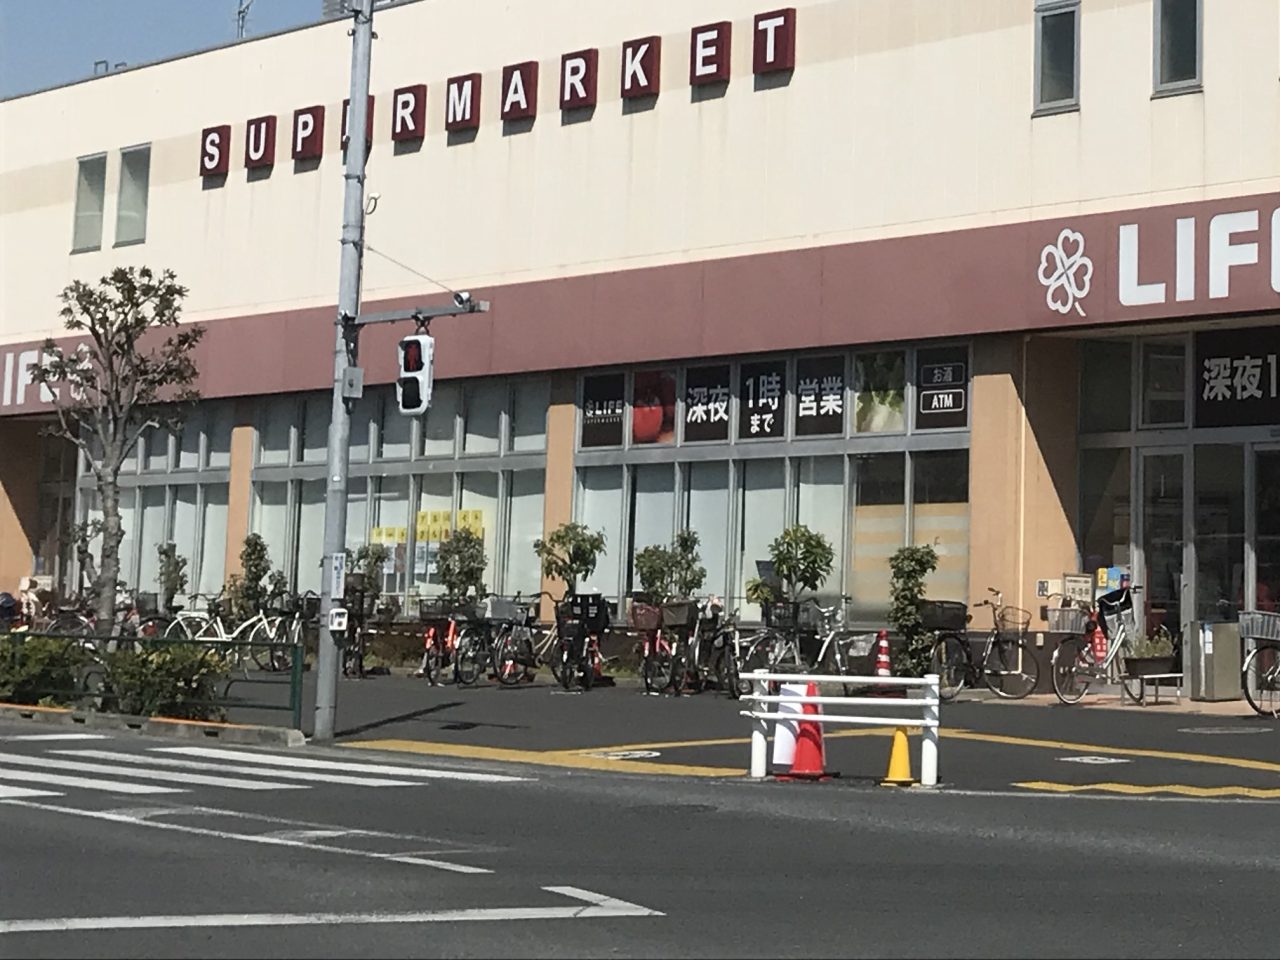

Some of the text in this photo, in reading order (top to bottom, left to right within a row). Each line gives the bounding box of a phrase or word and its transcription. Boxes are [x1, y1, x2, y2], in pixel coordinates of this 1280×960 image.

[203, 16, 785, 170] SUPRMARKET
[686, 371, 844, 434] 深夜 1時 まで 営業
[931, 393, 953, 409] ATM
